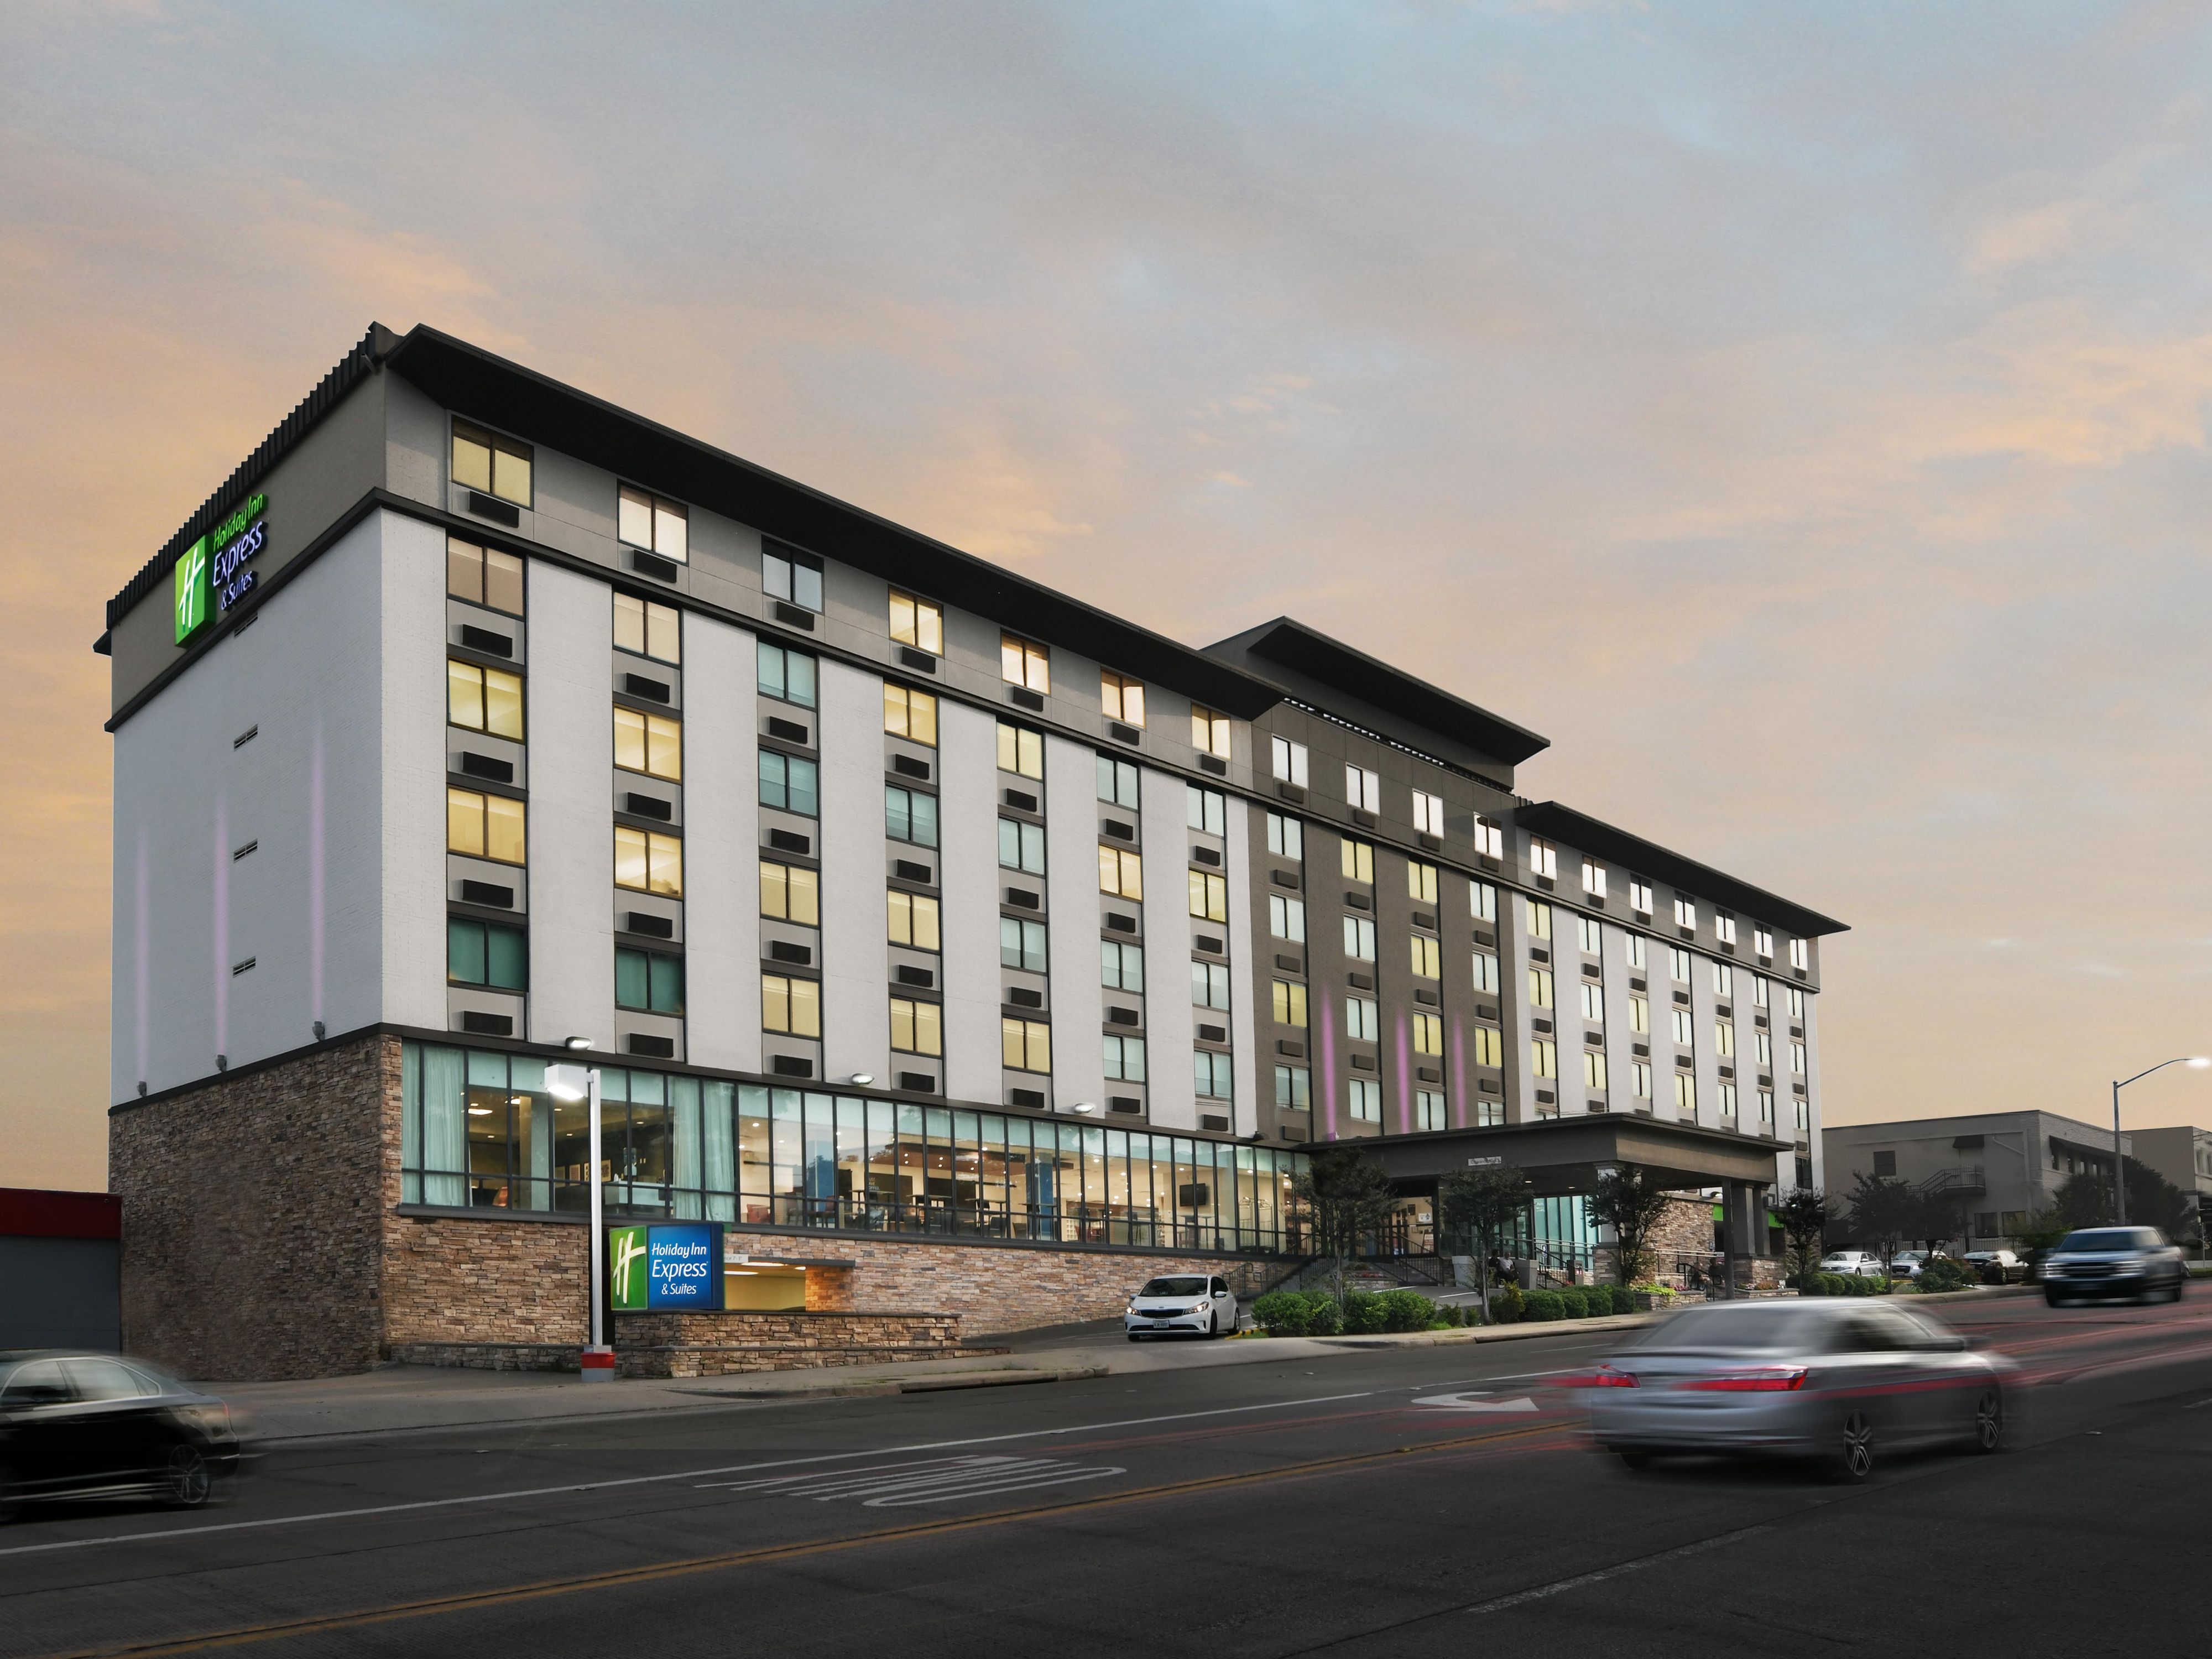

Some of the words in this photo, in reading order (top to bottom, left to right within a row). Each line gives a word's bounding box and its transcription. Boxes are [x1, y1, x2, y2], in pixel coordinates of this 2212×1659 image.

[213, 509, 247, 552] Holiday
[248, 493, 263, 520] Inn
[213, 520, 263, 587] Express
[221, 589, 227, 611] &
[228, 570, 253, 604] Suites
[651, 1243, 690, 1258] Holiday
[691, 1243, 706, 1255] Inn
[651, 1259, 707, 1282] Express
[661, 1284, 668, 1295] &
[670, 1283, 697, 1295] Suites
